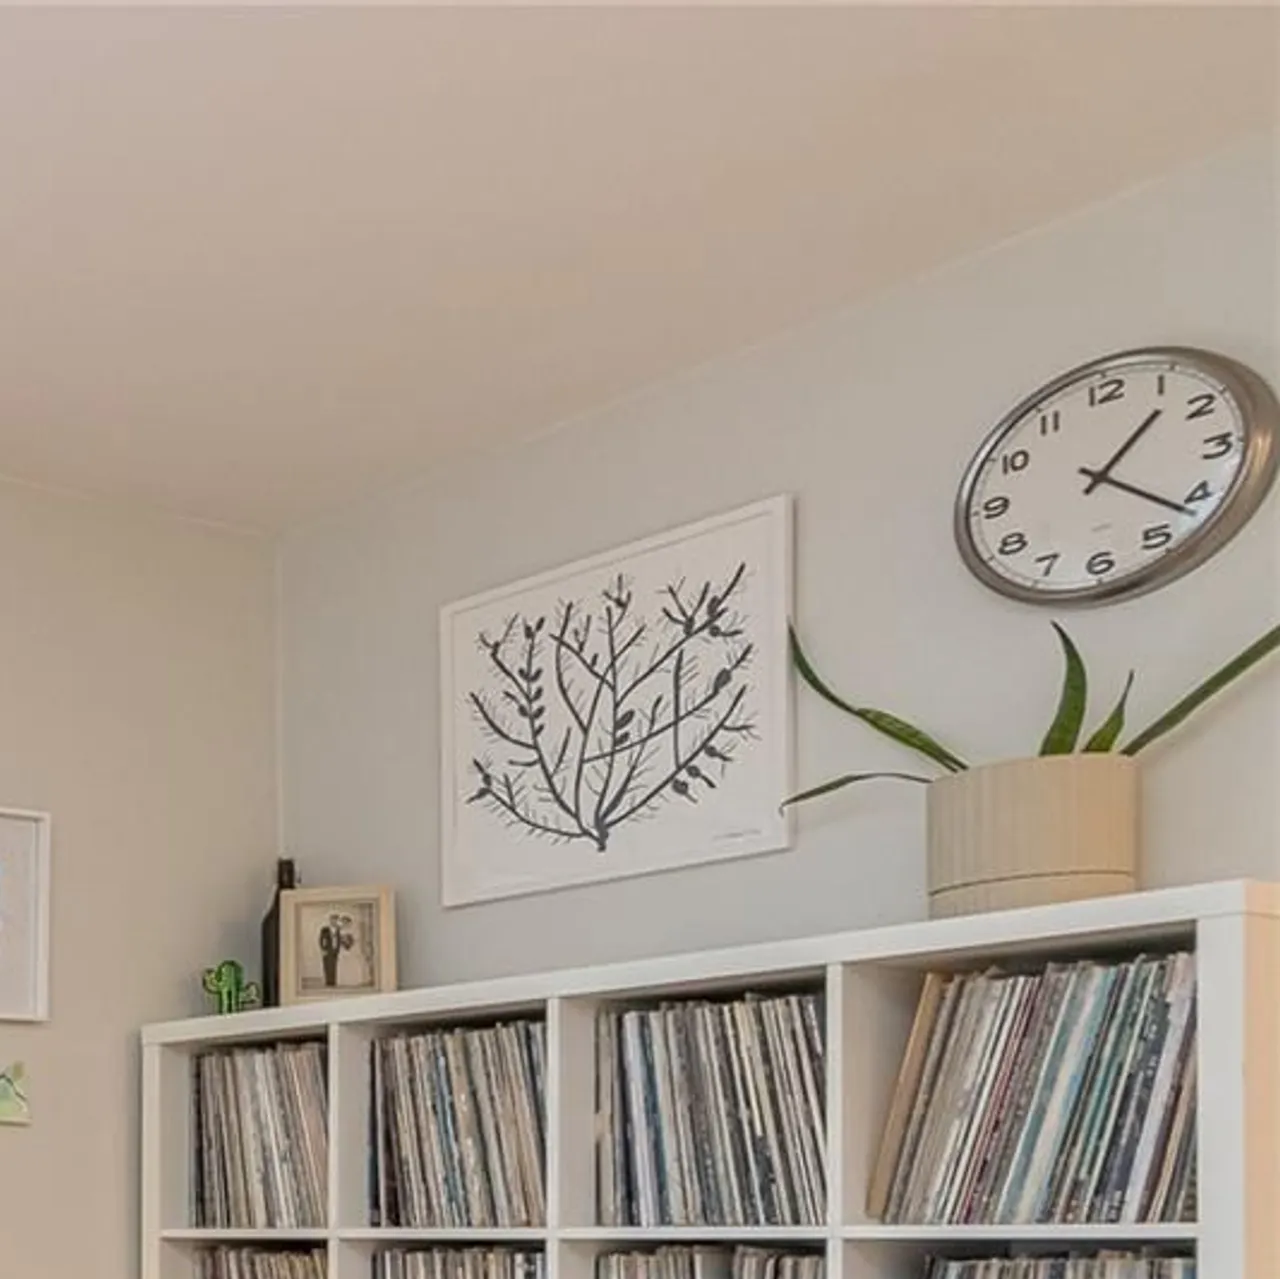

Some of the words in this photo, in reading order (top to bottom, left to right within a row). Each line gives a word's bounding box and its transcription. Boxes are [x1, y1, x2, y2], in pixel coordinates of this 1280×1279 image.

[1089, 378, 1125, 406] 12
[1157, 374, 1165, 396] 1
[1186, 393, 1215, 420] 2
[1040, 410, 1060, 436] 11
[1202, 432, 1233, 460] 3
[1002, 450, 1029, 475] 10
[1184, 481, 1214, 504] 4
[983, 496, 1010, 519] 9
[998, 533, 1028, 556] 8
[1141, 524, 1172, 550] 5
[1036, 553, 1060, 577] 7
[1086, 552, 1115, 575] 6
